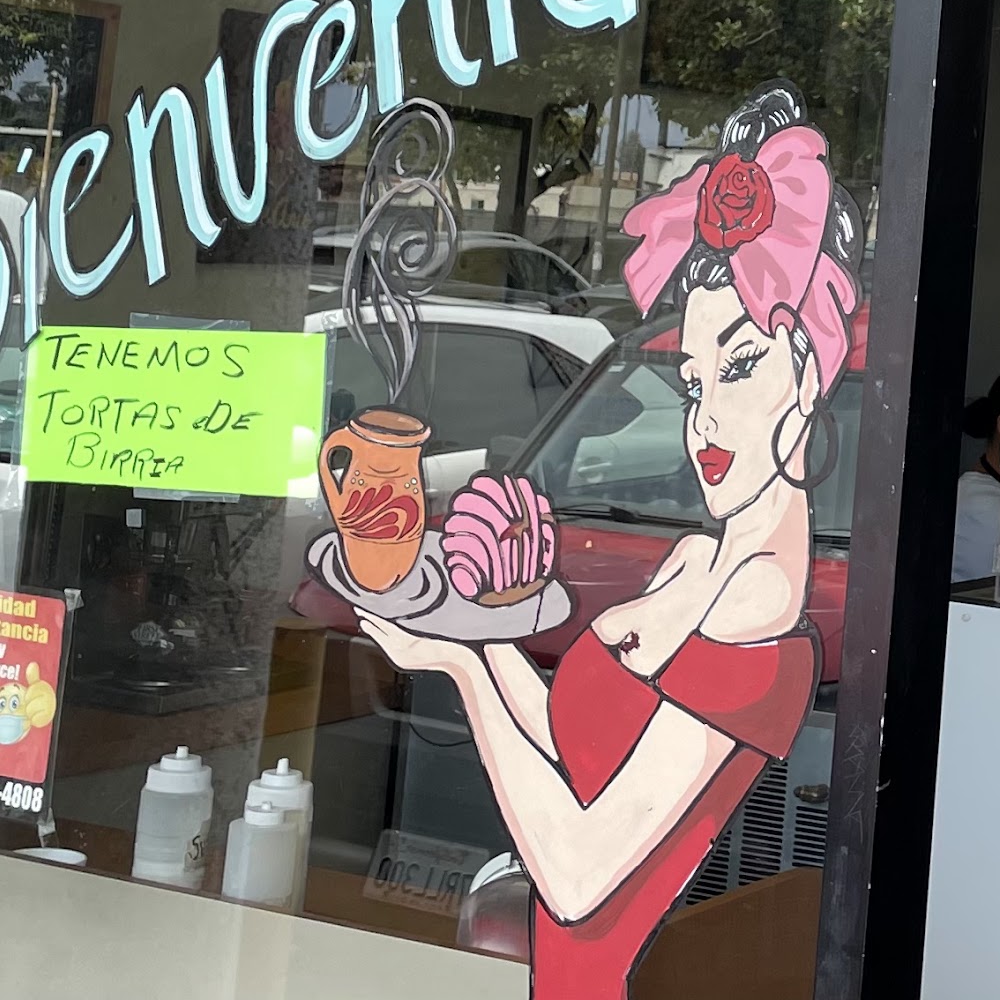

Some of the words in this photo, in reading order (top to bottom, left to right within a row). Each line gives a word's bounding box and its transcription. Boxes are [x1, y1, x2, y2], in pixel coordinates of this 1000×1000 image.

[45, 333, 250, 378] TENEMOS
[38, 388, 182, 433] TORTAS
[65, 432, 185, 481] BIRRIA
[0, 620, 49, 644] ancia
